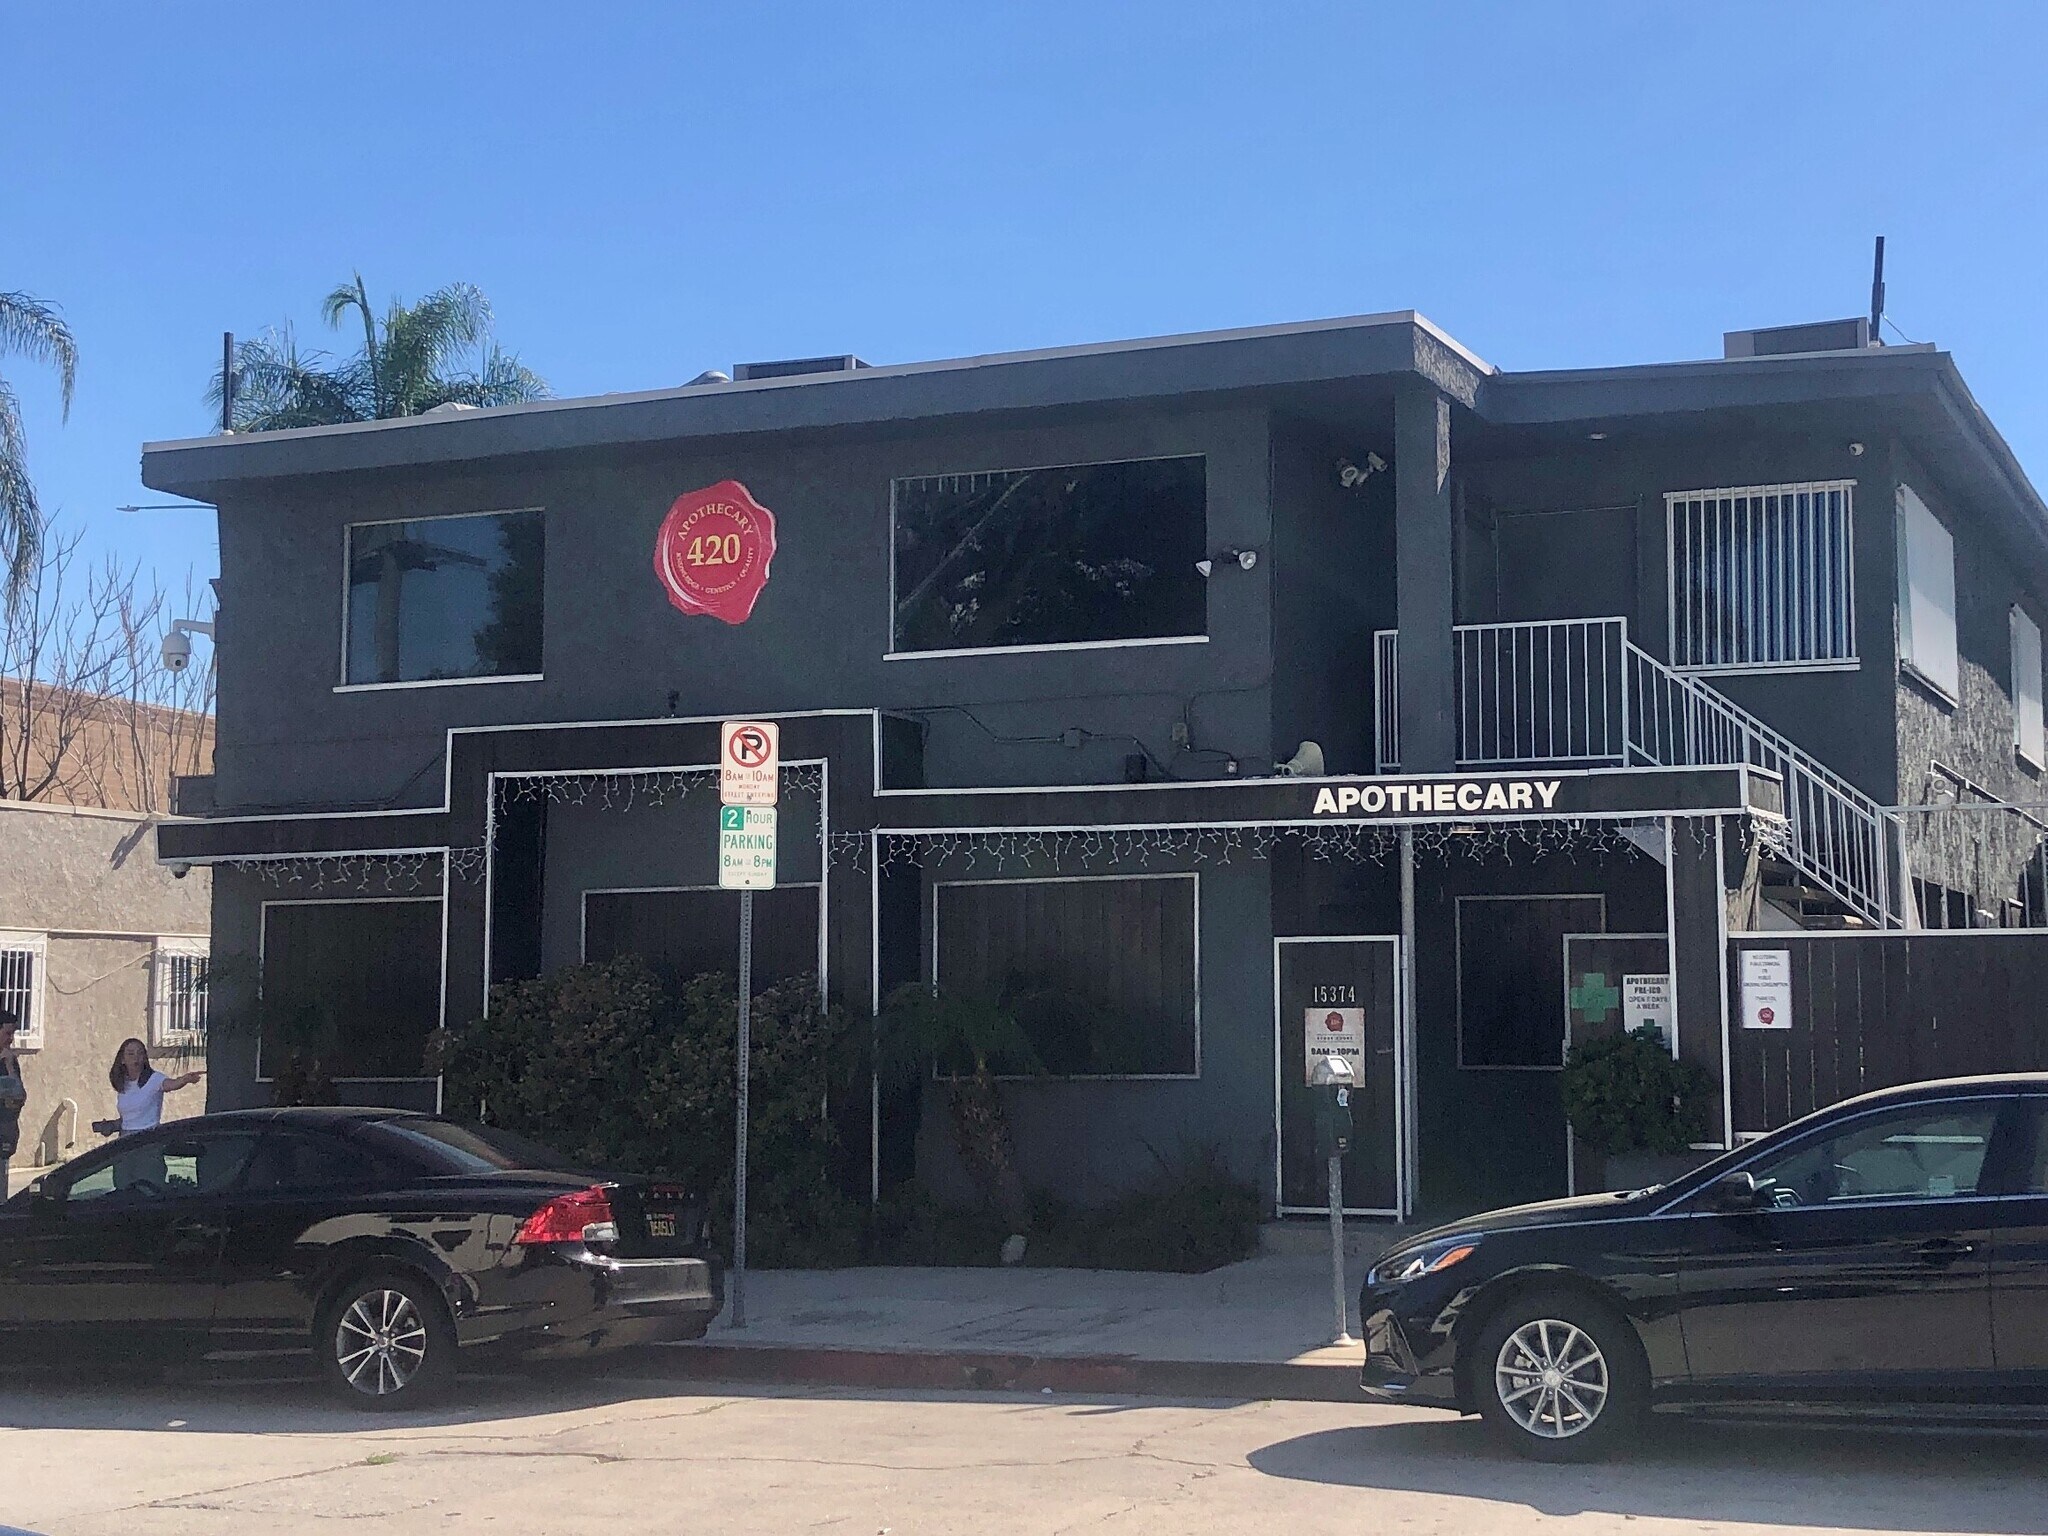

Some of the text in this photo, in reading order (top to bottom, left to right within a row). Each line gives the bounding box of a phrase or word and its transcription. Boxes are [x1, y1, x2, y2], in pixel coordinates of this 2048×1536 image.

[677, 503, 754, 540] APOTHECARY
[687, 533, 741, 567] 420
[705, 581, 737, 594] GENETICS
[740, 546, 754, 578] QUALITY
[725, 769, 744, 781] 8AM
[752, 770, 774, 782] 10AM
[1313, 780, 1561, 814] APOTHECARY
[727, 809, 773, 828] 2 HOUR
[723, 834, 773, 850] PARKING
[723, 854, 744, 867] 8AM
[753, 855, 773, 868] 8PM
[1626, 977, 1669, 985] APOTHECARY
[1314, 985, 1355, 1003] 15374
[1336, 1047, 1360, 1056] 10PM
